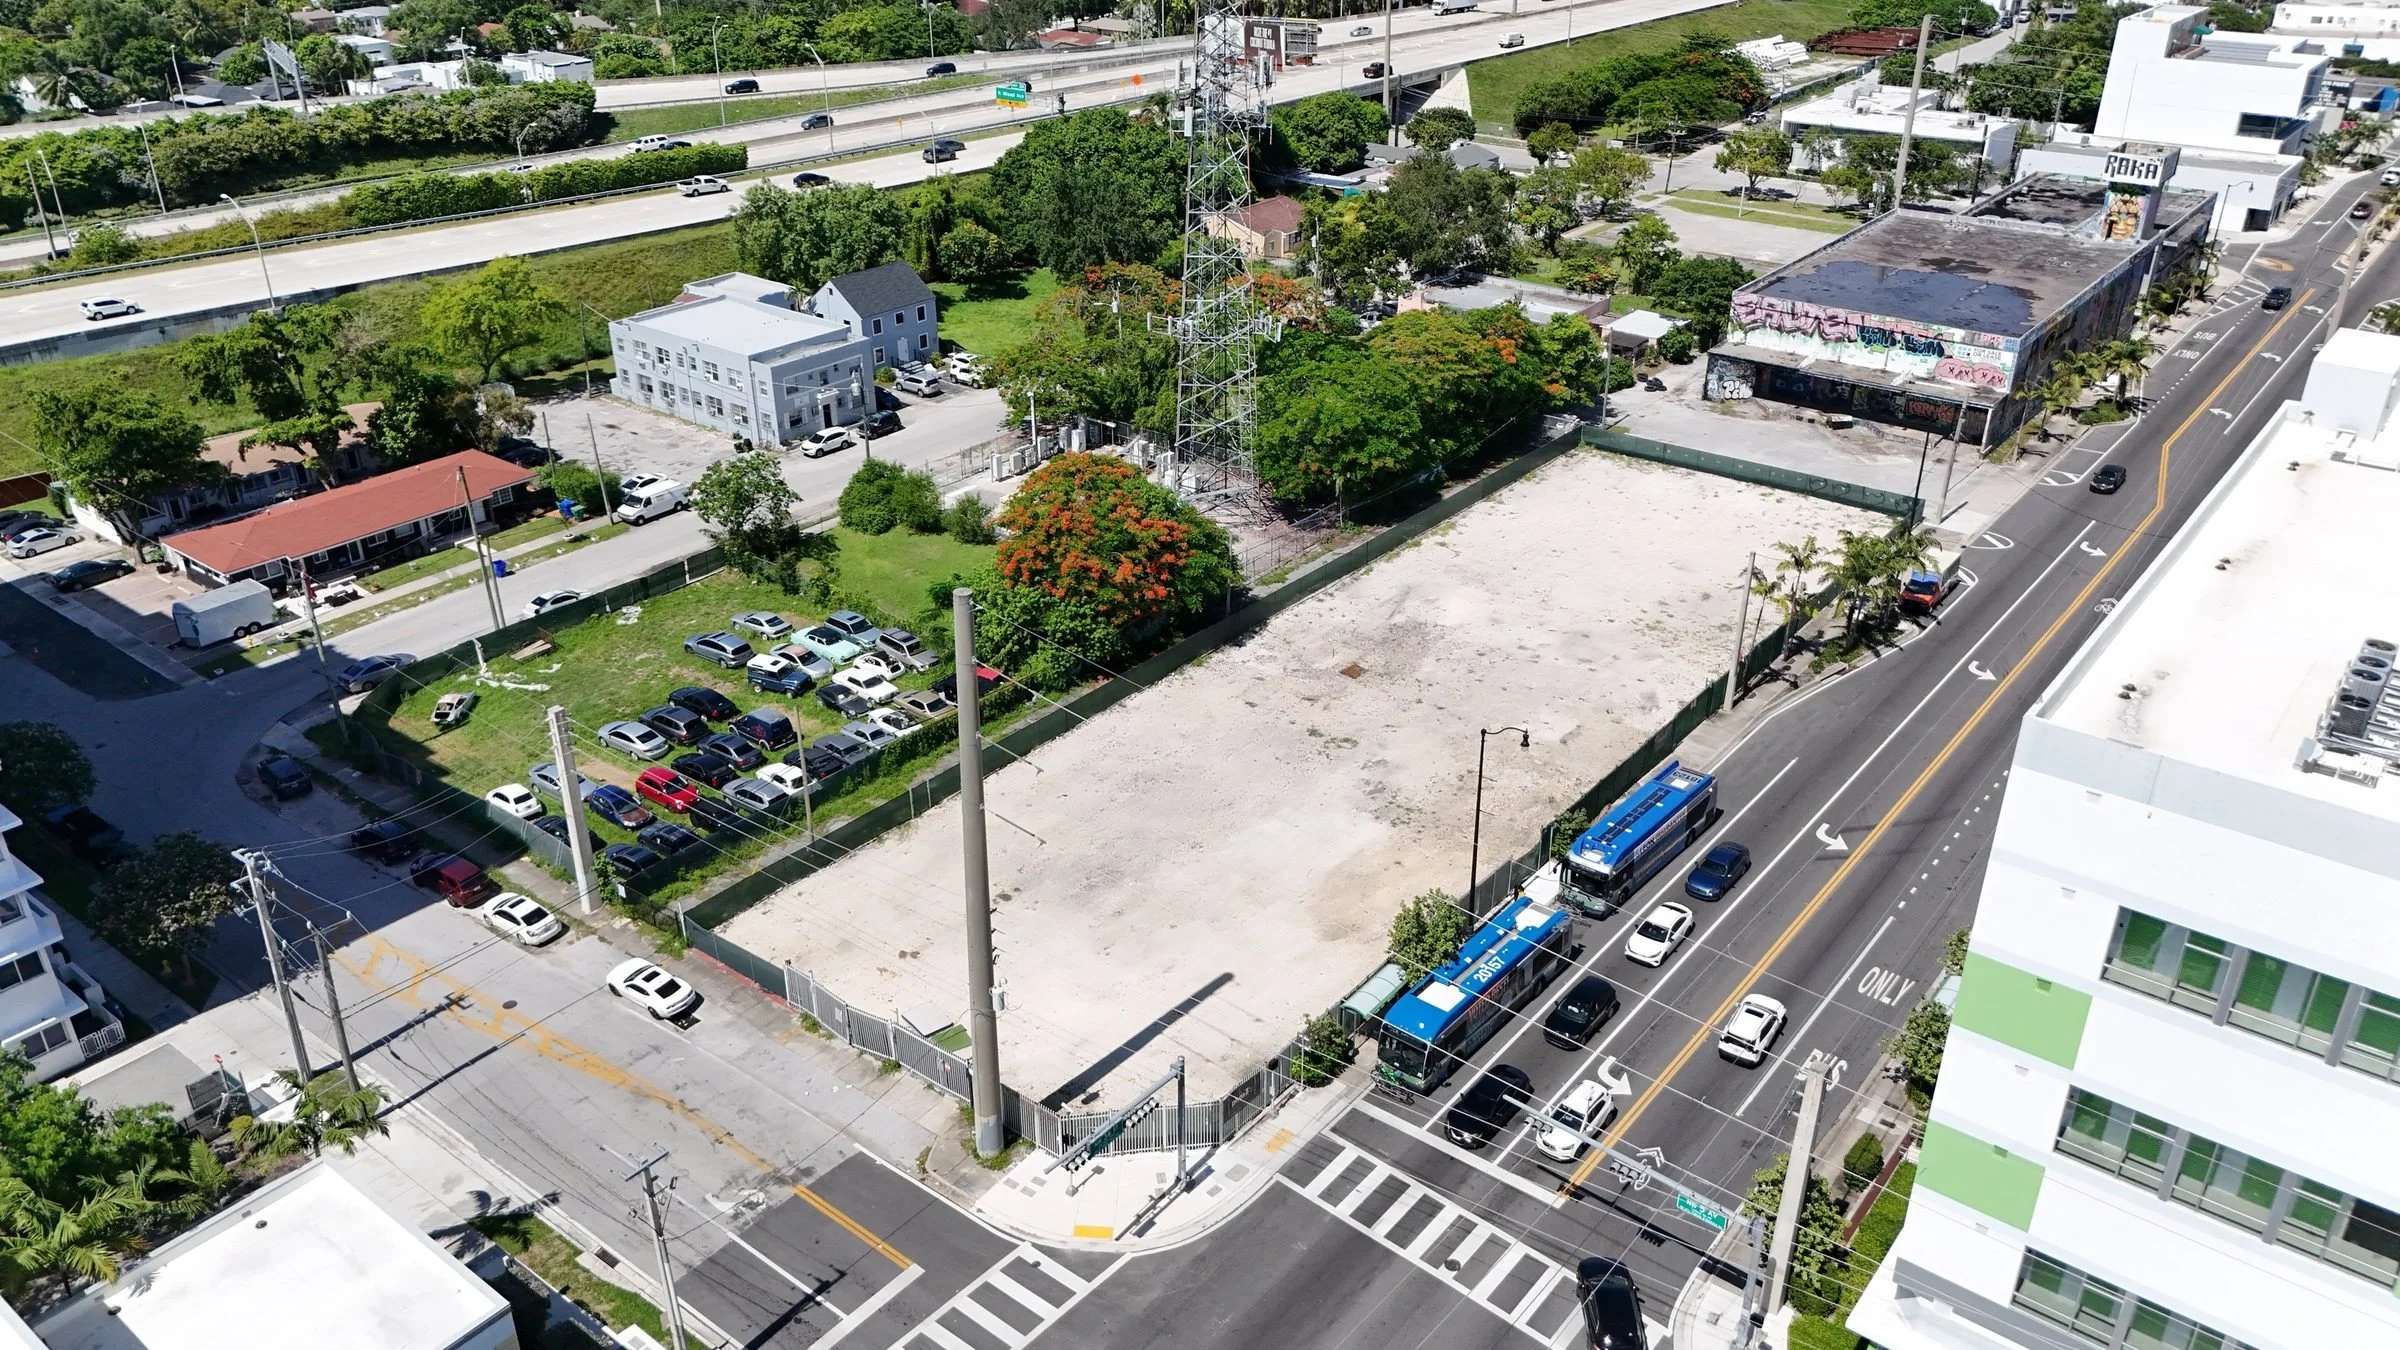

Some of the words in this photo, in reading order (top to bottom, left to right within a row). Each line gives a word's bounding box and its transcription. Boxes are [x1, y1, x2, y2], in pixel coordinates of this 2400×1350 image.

[2193, 331, 2217, 341] BUS
[2172, 349, 2200, 359] ONLY
[1473, 955, 1506, 984] 20157
[1857, 966, 1916, 1008] ONLY
[1794, 1048, 1848, 1092] BS
